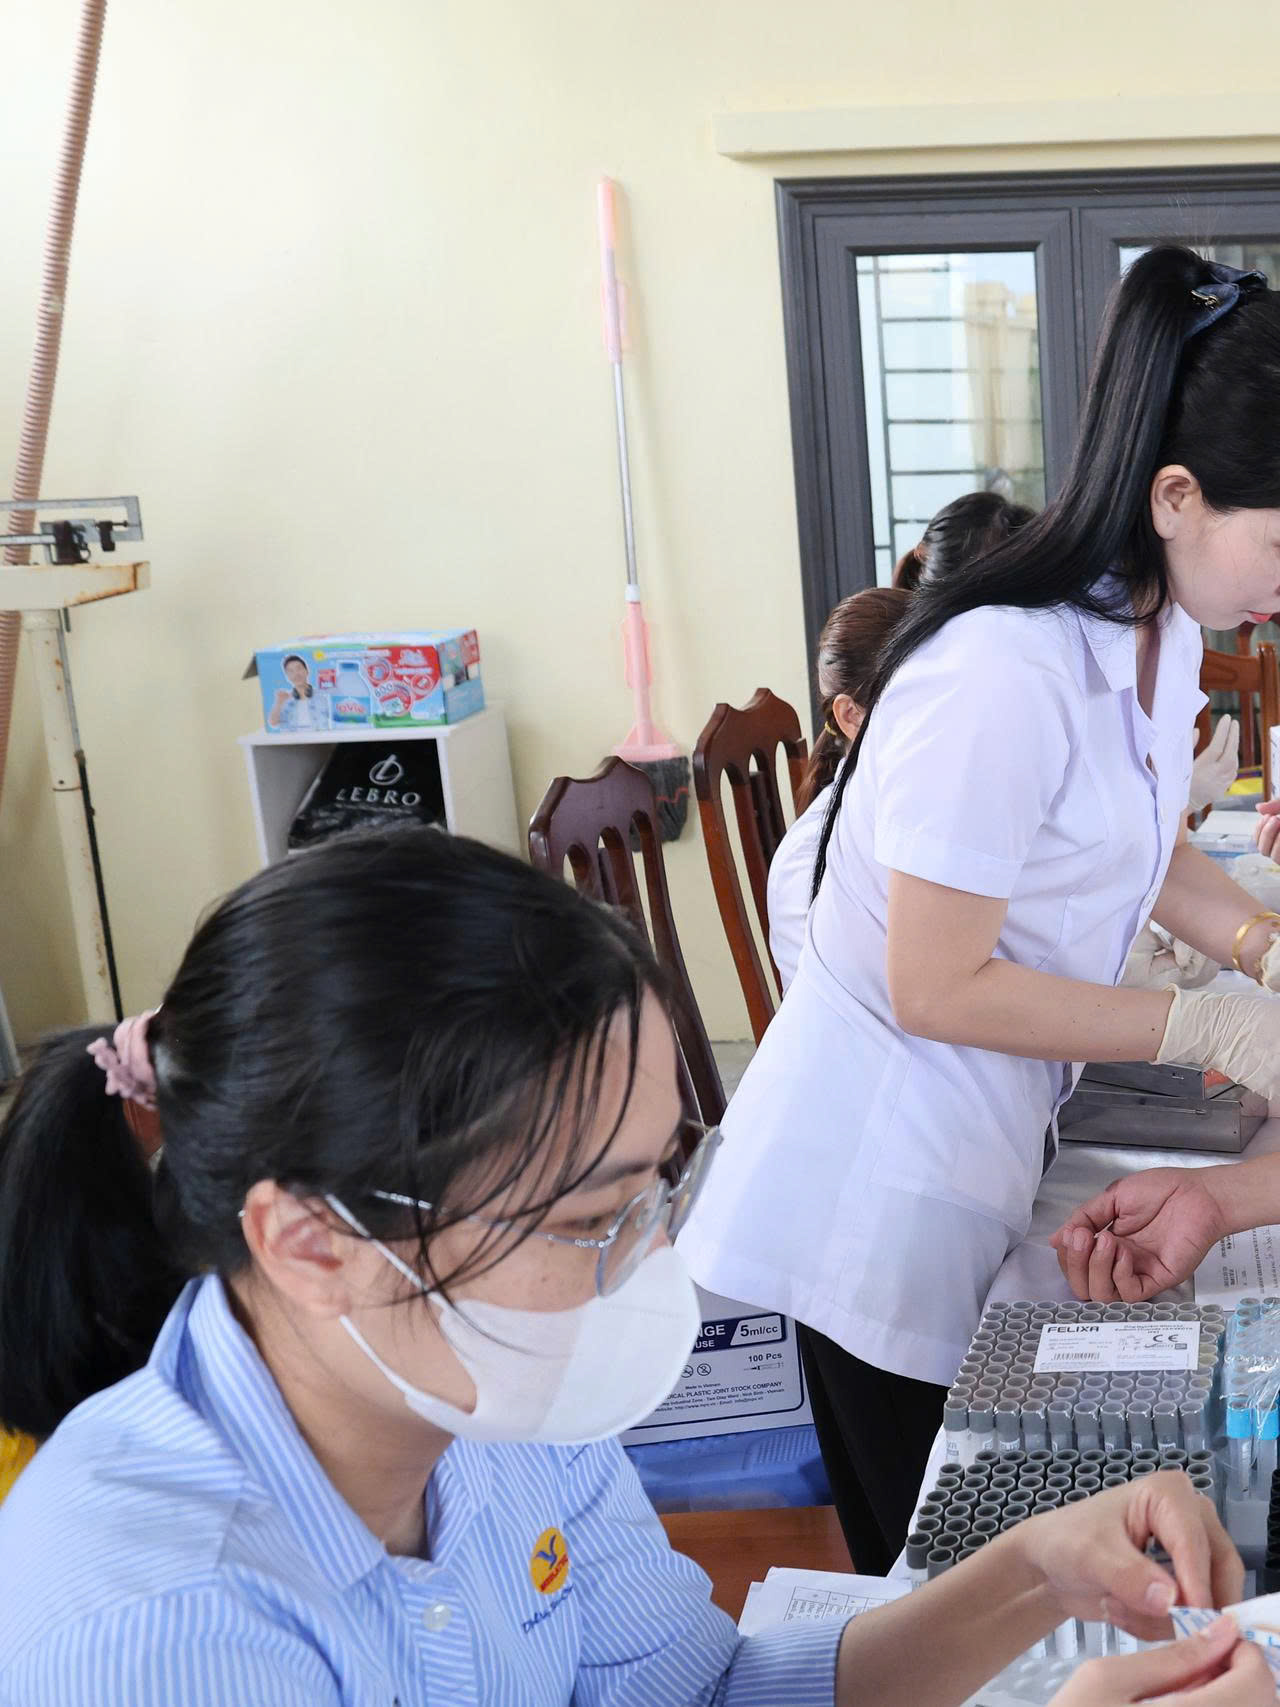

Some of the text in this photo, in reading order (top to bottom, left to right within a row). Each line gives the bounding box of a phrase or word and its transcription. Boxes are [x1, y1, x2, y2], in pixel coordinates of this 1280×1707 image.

[336, 786, 420, 806] LEBRO
[740, 1324, 778, 1337] 5ml/cc
[695, 1339, 715, 1349] USE
[748, 1352, 783, 1362] 100 Pcs
[686, 1389, 712, 1398] PLASTIC
[712, 1387, 730, 1395] JOINT
[730, 1385, 751, 1393] STOCK
[752, 1381, 783, 1390] COMPANY
